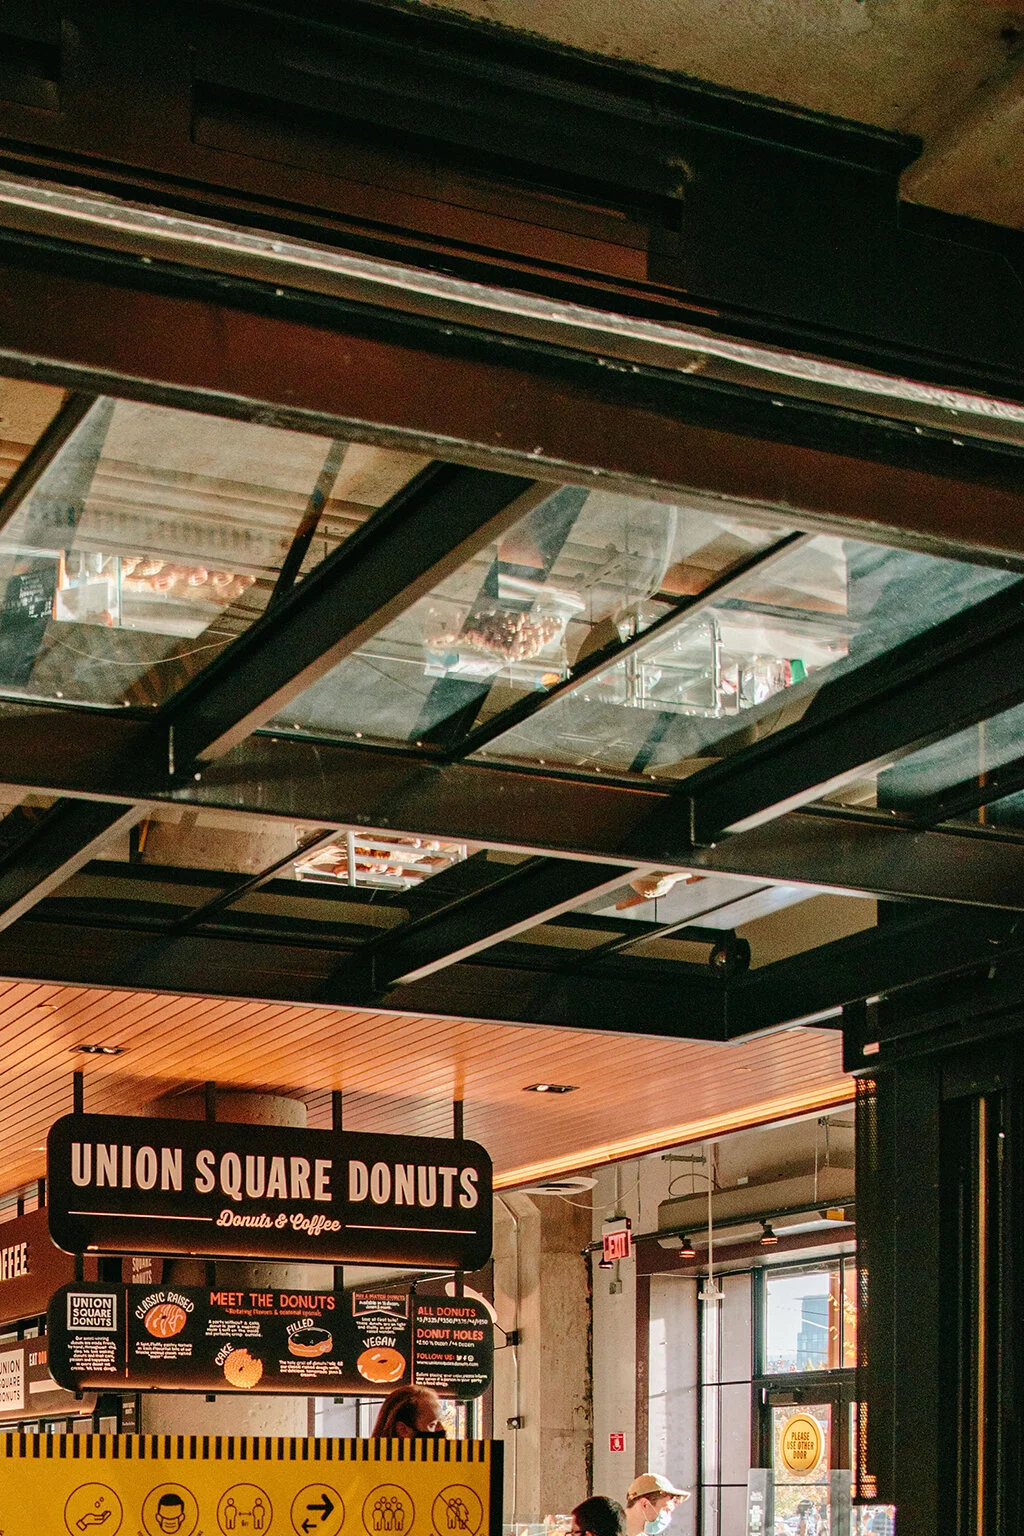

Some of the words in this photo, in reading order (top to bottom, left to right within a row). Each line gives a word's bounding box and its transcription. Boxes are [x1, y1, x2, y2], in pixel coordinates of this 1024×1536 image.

[70, 1142, 183, 1191] UNION
[194, 1148, 333, 1202] SQUARE
[348, 1159, 479, 1209] DONUTS
[216, 1209, 273, 1228] Donuts
[274, 1214, 288, 1228] &
[290, 1214, 342, 1236] Coffee
[608, 1232, 627, 1260] EXIT
[72, 1298, 112, 1308] UNION
[135, 1291, 166, 1320] CLASSIC
[166, 1292, 194, 1313] RAISED
[210, 1292, 244, 1306] MEET
[249, 1293, 274, 1307] THE
[280, 1294, 336, 1310] DONUTS
[72, 1308, 112, 1318] SQUARE
[418, 1306, 434, 1316] ALL
[436, 1307, 476, 1318] DONUTS
[72, 1318, 112, 1327] DONUTS
[286, 1318, 314, 1336] FILLED
[416, 1328, 450, 1340] DONUT
[454, 1330, 484, 1341] HOLES
[362, 1336, 396, 1348] VEGAN
[29, 1352, 38, 1366] EAT
[214, 1342, 234, 1366] CAKE
[792, 1432, 810, 1440] PLEASE
[786, 1442, 796, 1450] USE
[797, 1442, 814, 1450] OTHER
[792, 1450, 807, 1460] DOOR
